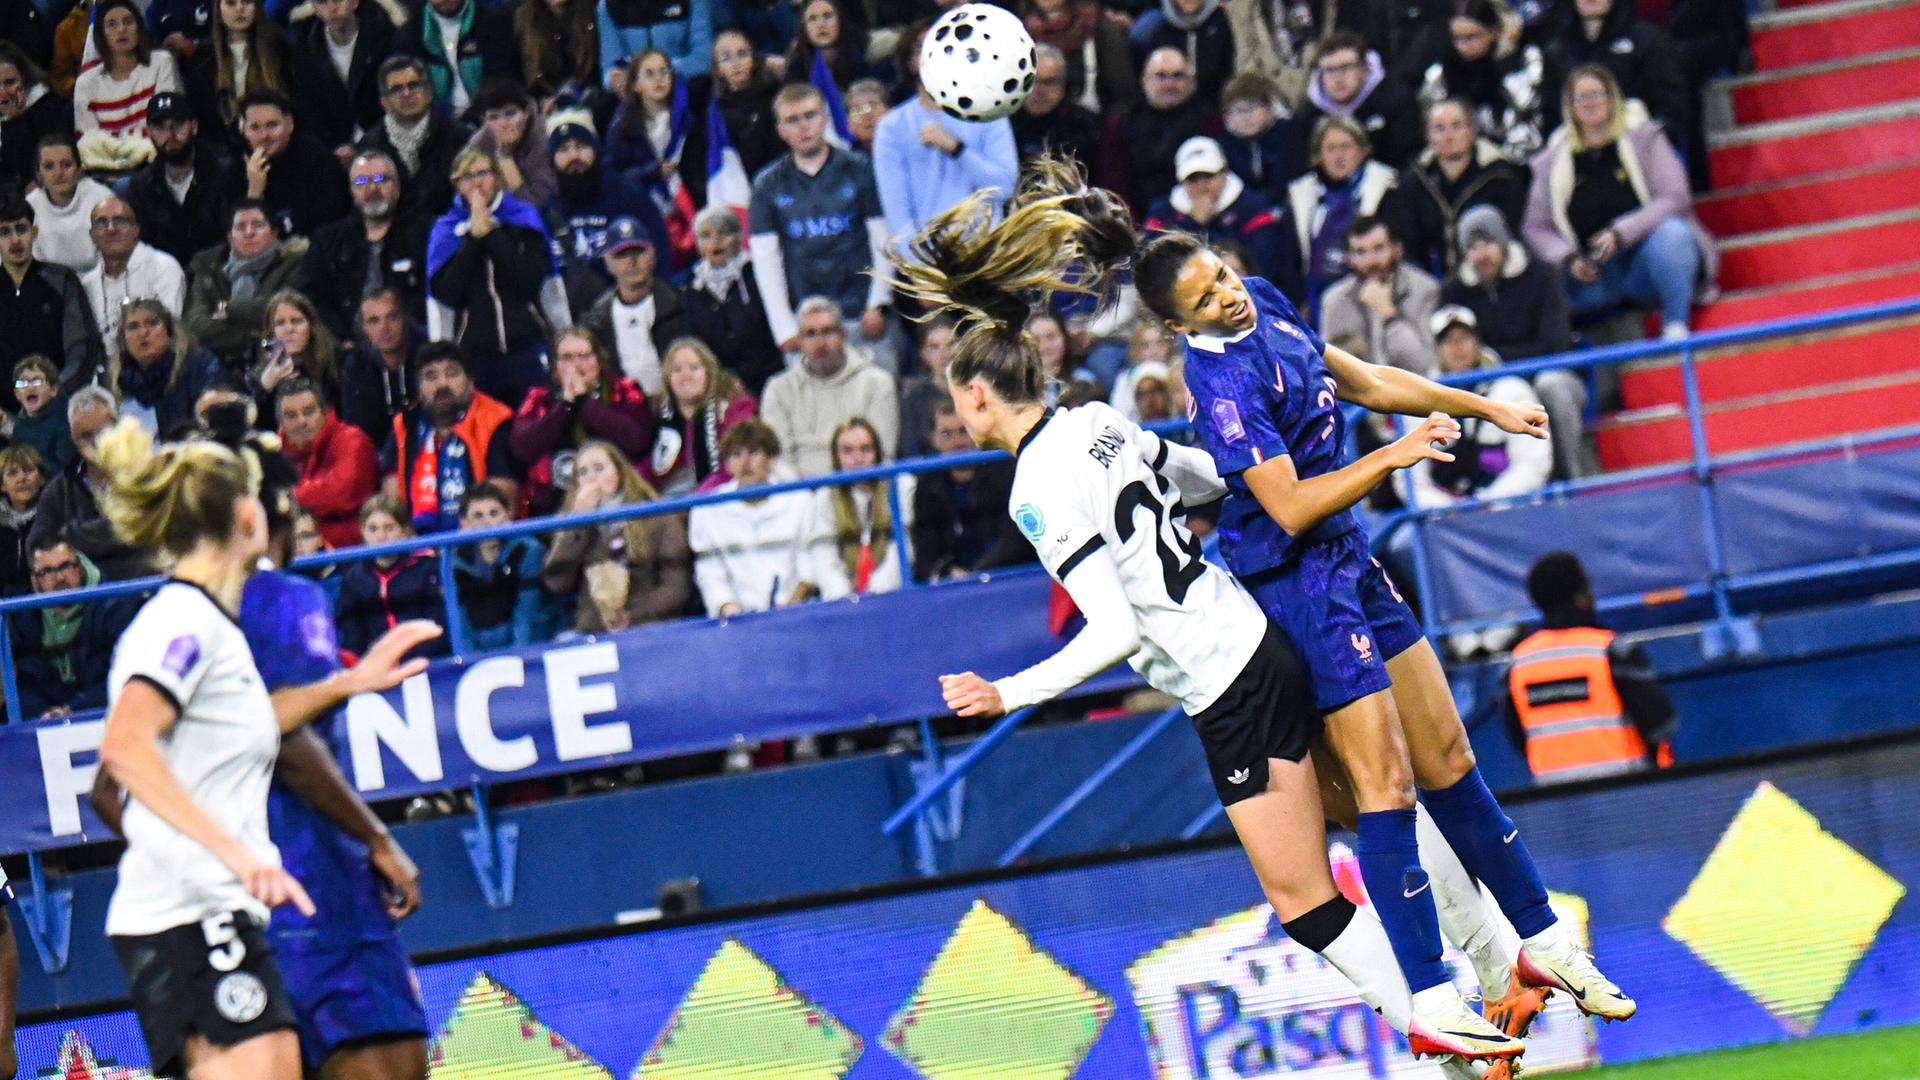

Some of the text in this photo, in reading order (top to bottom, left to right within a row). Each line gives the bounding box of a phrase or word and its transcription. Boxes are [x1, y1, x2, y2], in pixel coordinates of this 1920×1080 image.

[1088, 425, 1126, 469] BRAND
[37, 641, 633, 837] FNCE
[202, 911, 247, 972] 5
